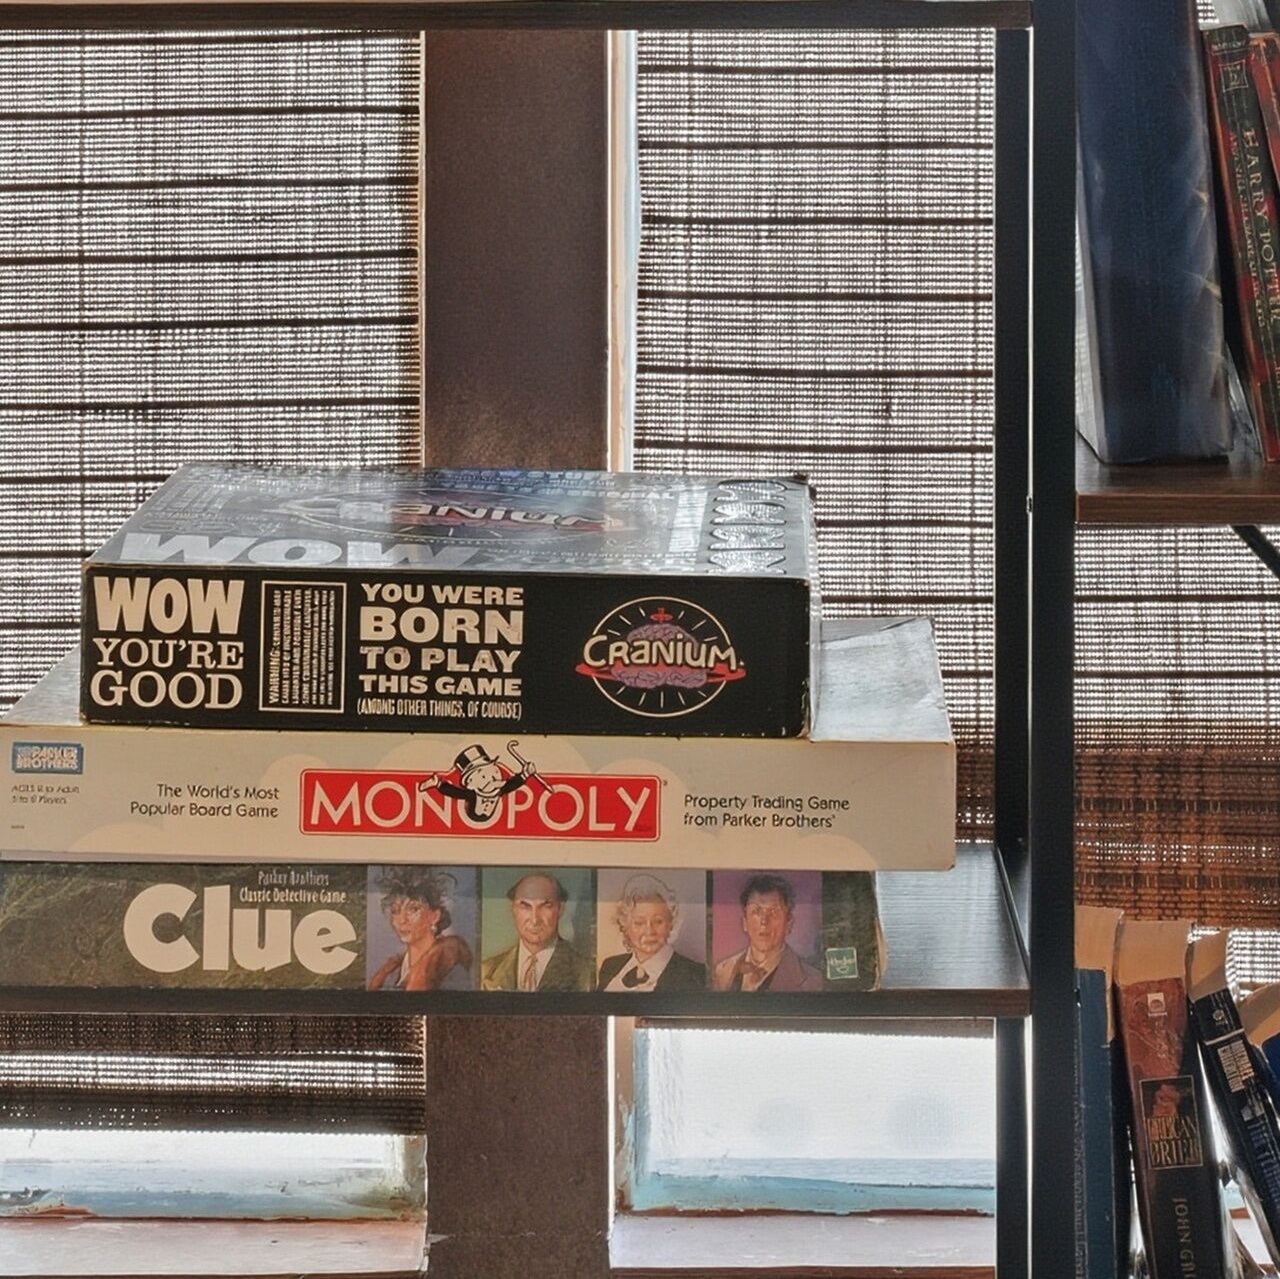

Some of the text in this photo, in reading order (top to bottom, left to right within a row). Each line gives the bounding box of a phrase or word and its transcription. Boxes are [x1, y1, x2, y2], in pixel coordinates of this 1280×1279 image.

[1243, 127, 1270, 222] HARRY
[120, 532, 483, 569] WOW
[93, 576, 245, 635] WOW
[360, 583, 525, 606] YOU WERE
[360, 606, 524, 645] BORN
[92, 637, 245, 670] YOU'RE
[360, 646, 522, 674] TO PLAY
[90, 669, 244, 710] GOOD
[358, 674, 523, 697] THIS GAME
[397, 698, 427, 716] OTHER
[469, 701, 480, 717] OF
[157, 784, 280, 800] The World's Most
[310, 779, 652, 832] MONOPOLY
[683, 794, 850, 812] Property Trading Game
[130, 801, 279, 818] Popular Board Game
[683, 812, 718, 826] from
[722, 813, 767, 827] Parker
[257, 871, 330, 886] Parker Brothers
[239, 888, 347, 904] Classic Detective Game
[123, 883, 358, 975] Clue
[1173, 1198, 1192, 1243] JOHN
